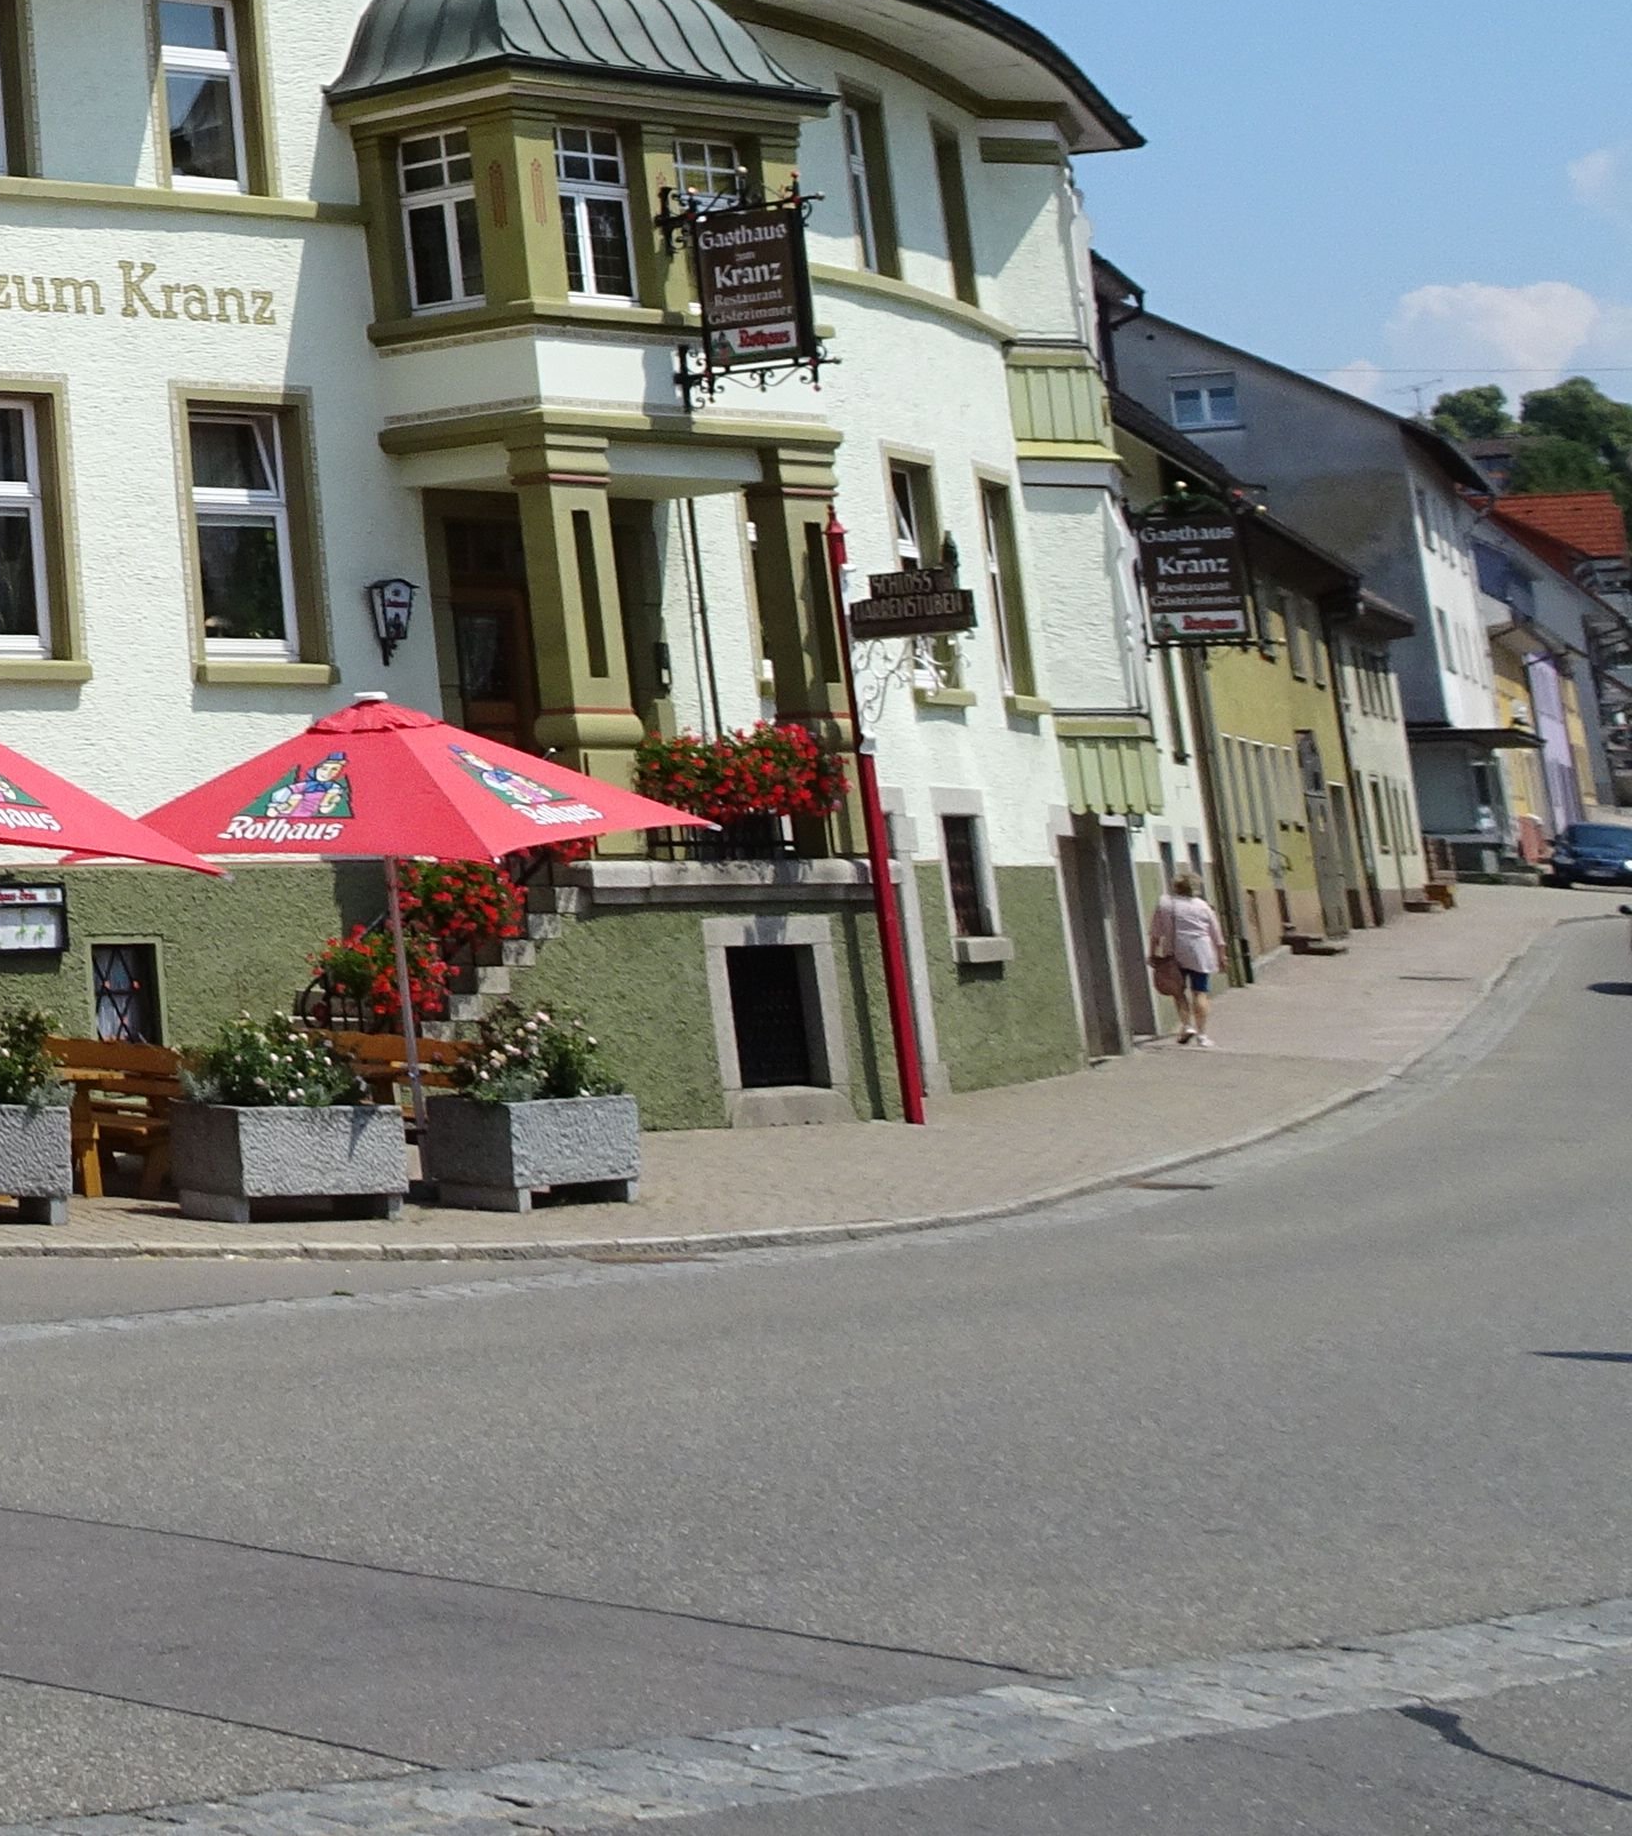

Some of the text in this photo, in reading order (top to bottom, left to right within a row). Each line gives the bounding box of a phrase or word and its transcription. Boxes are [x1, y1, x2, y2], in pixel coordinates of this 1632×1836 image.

[699, 223, 786, 249] Gasthaus
[714, 262, 783, 289] Kranz
[118, 260, 277, 326] Kranz
[714, 288, 783, 308] Restaurant
[1139, 525, 1235, 543] Gasthaus
[1156, 556, 1230, 575] Kranz
[871, 570, 932, 595] SCHLOSS
[217, 816, 344, 843] Rothaus
